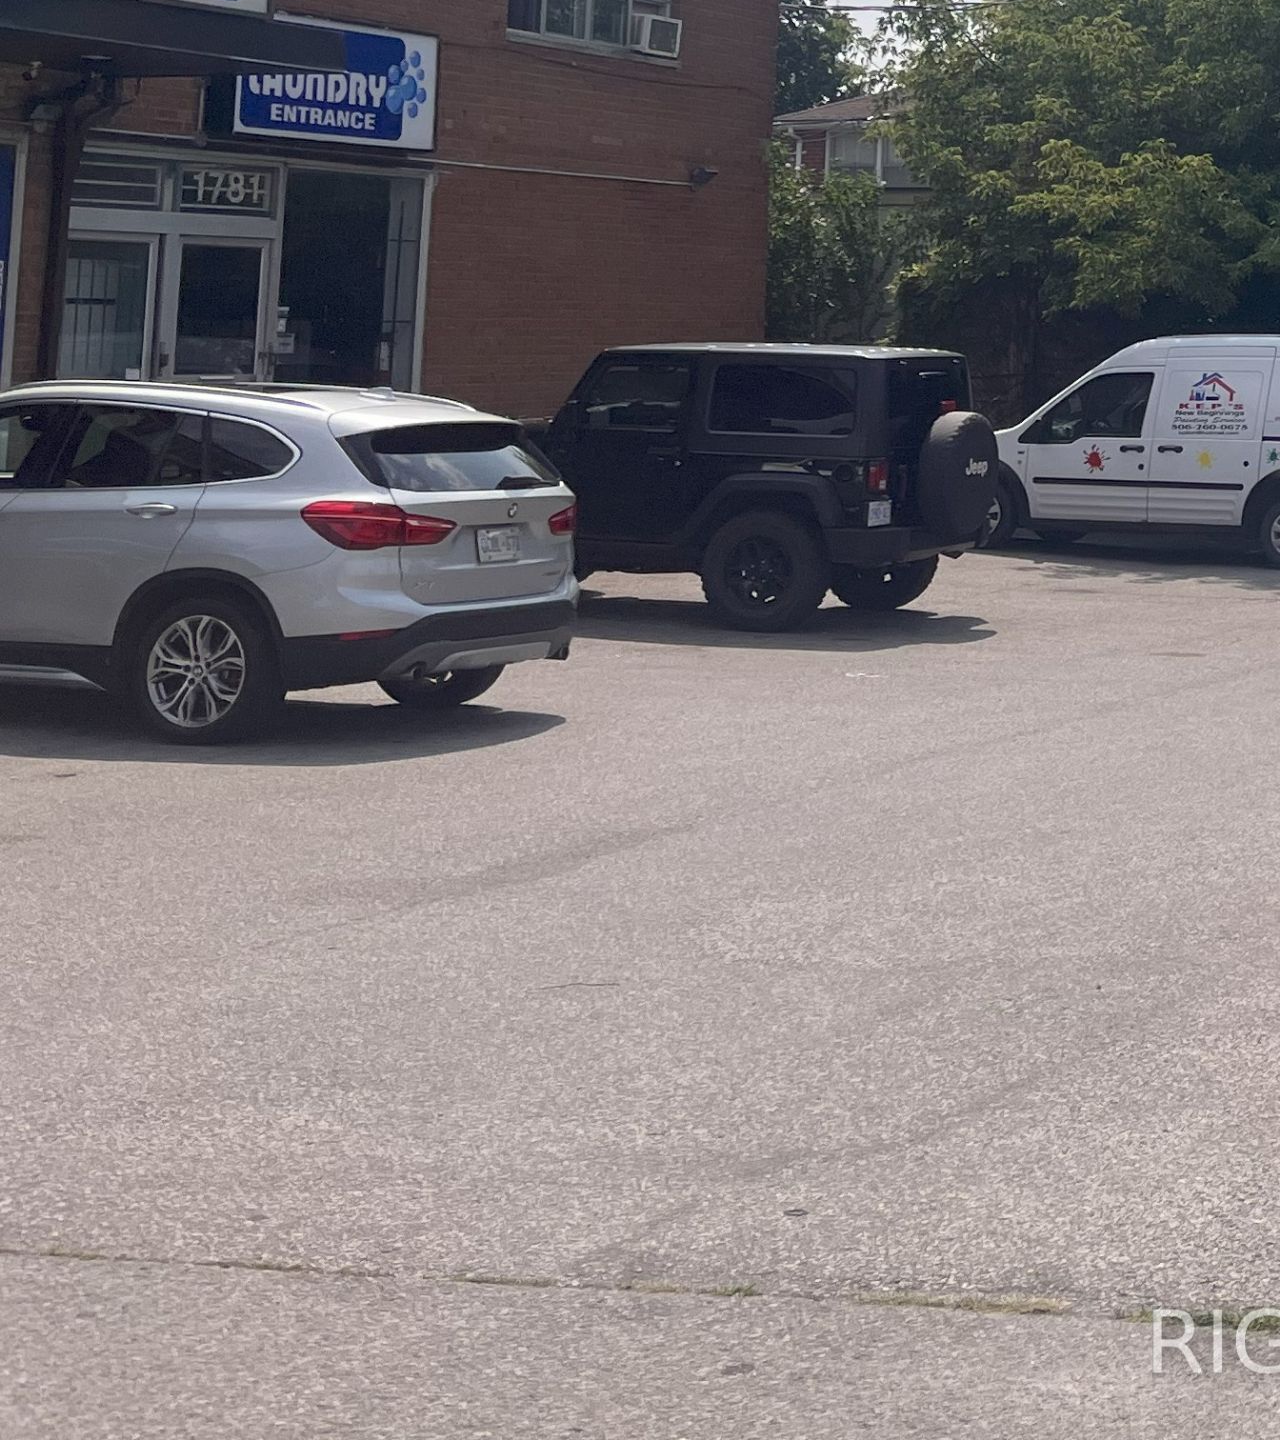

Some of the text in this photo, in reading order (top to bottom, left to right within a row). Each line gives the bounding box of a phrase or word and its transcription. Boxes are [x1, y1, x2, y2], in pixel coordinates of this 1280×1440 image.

[270, 103, 377, 131] ENTRANCE
[193, 169, 261, 204] 1781
[965, 458, 988, 477] Jeep
